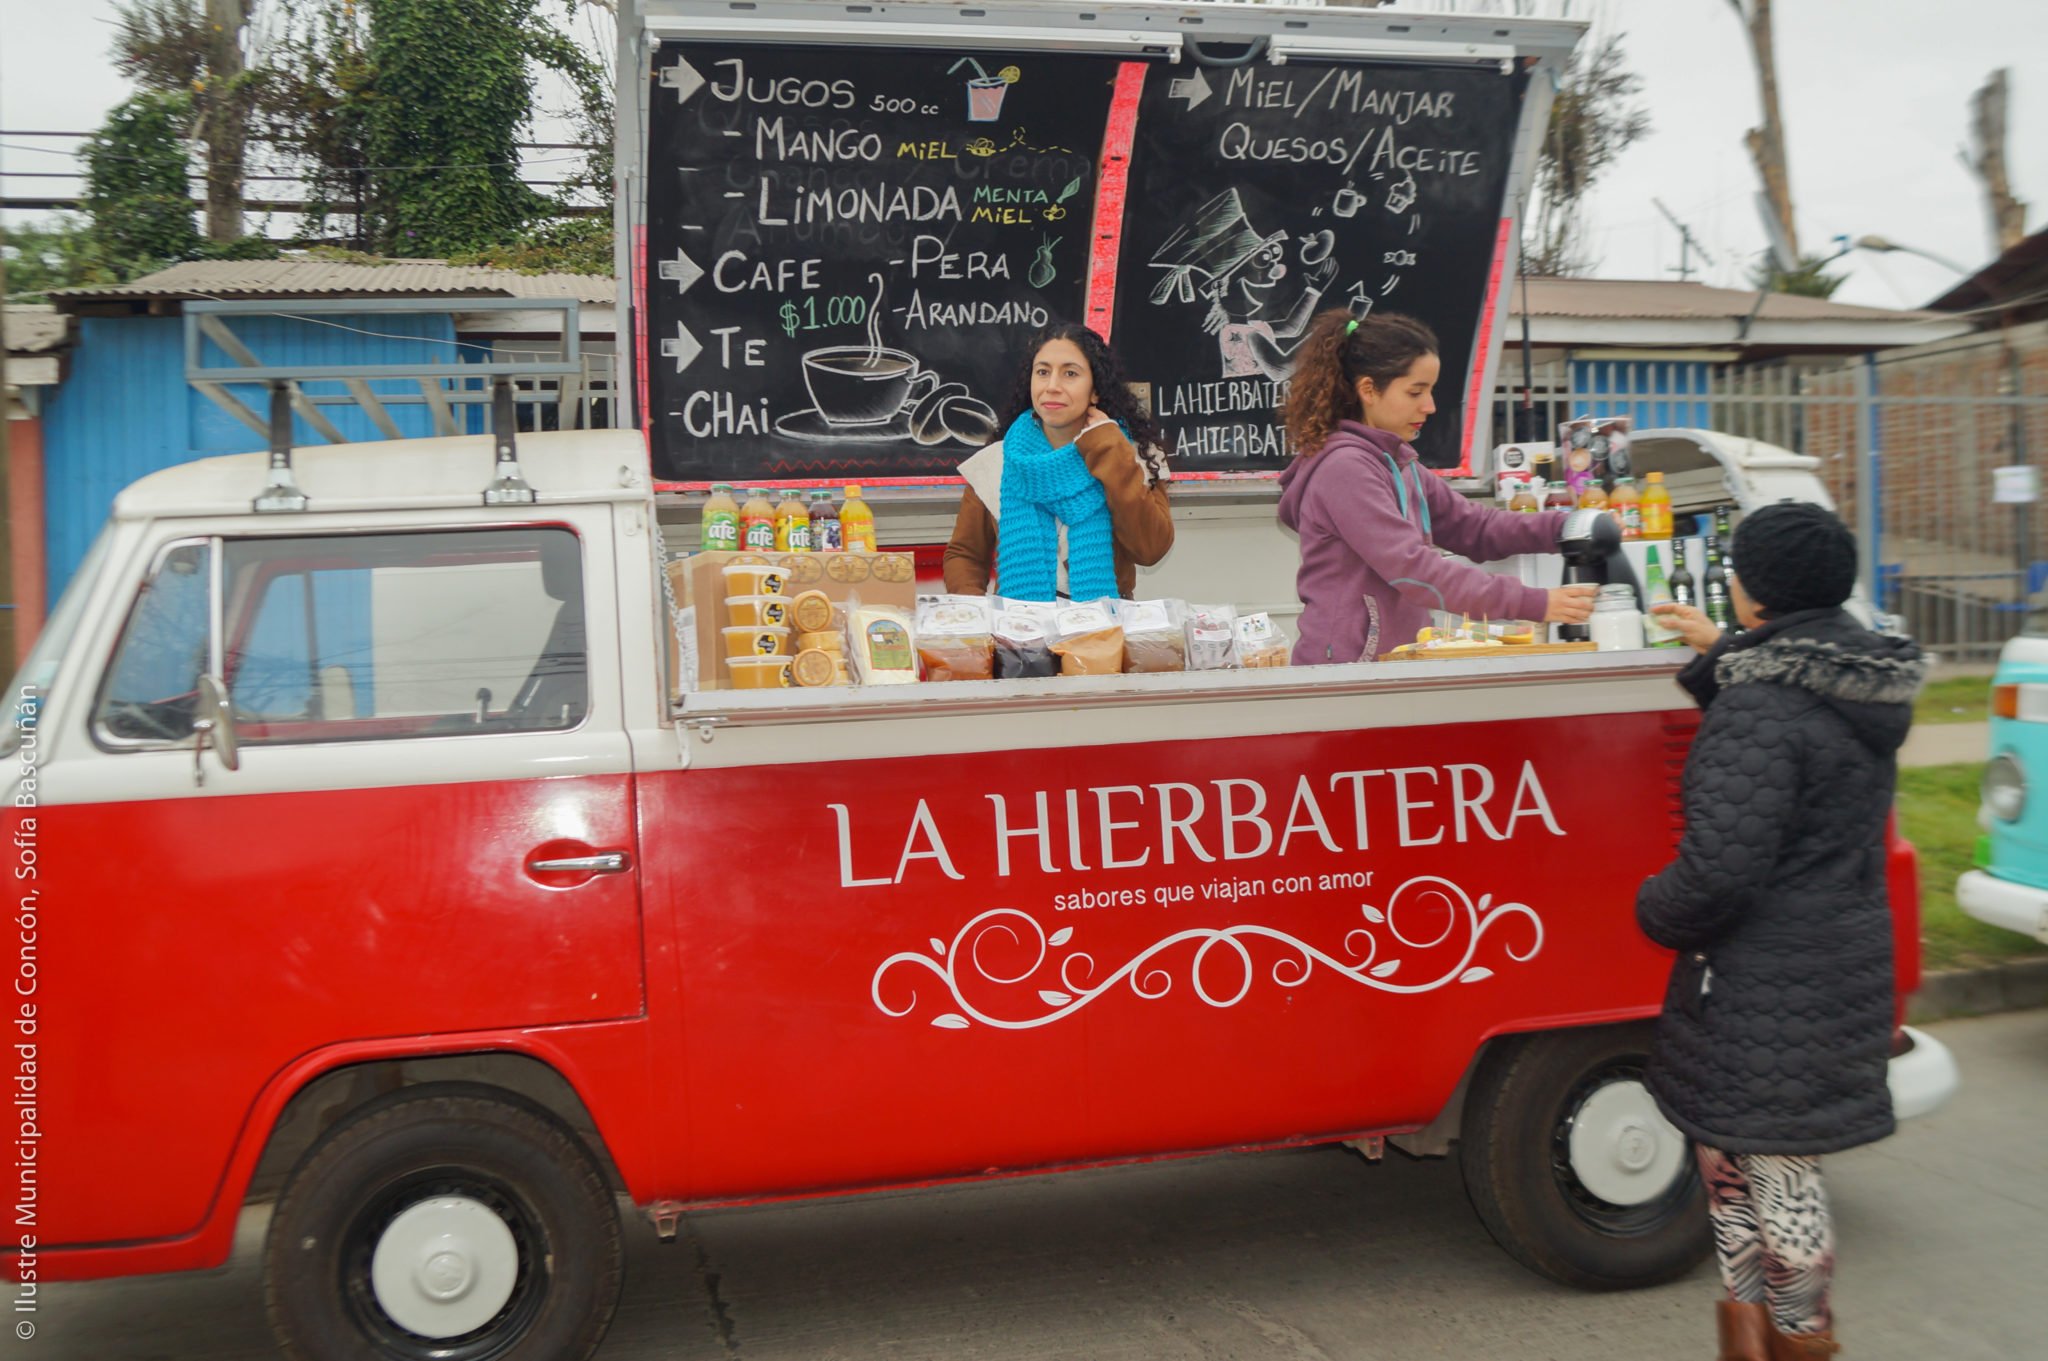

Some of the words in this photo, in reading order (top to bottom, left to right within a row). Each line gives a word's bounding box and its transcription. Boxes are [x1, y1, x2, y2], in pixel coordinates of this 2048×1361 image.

[711, 58, 855, 109] JUGOS
[869, 95, 916, 115] 500
[921, 103, 939, 115] cc
[756, 116, 882, 162] MANGO
[973, 186, 1048, 204] MENTA
[713, 249, 822, 293] CAFE
[780, 295, 866, 339] $1.000
[710, 326, 767, 369] TE
[826, 797, 965, 888] LA
[984, 760, 1566, 877] HIERBATERA
[1053, 887, 1147, 911] sabores
[1154, 885, 1195, 908] que
[1199, 878, 1266, 903] viajan
[1272, 878, 1312, 895] con
[1318, 870, 1375, 890] amor
